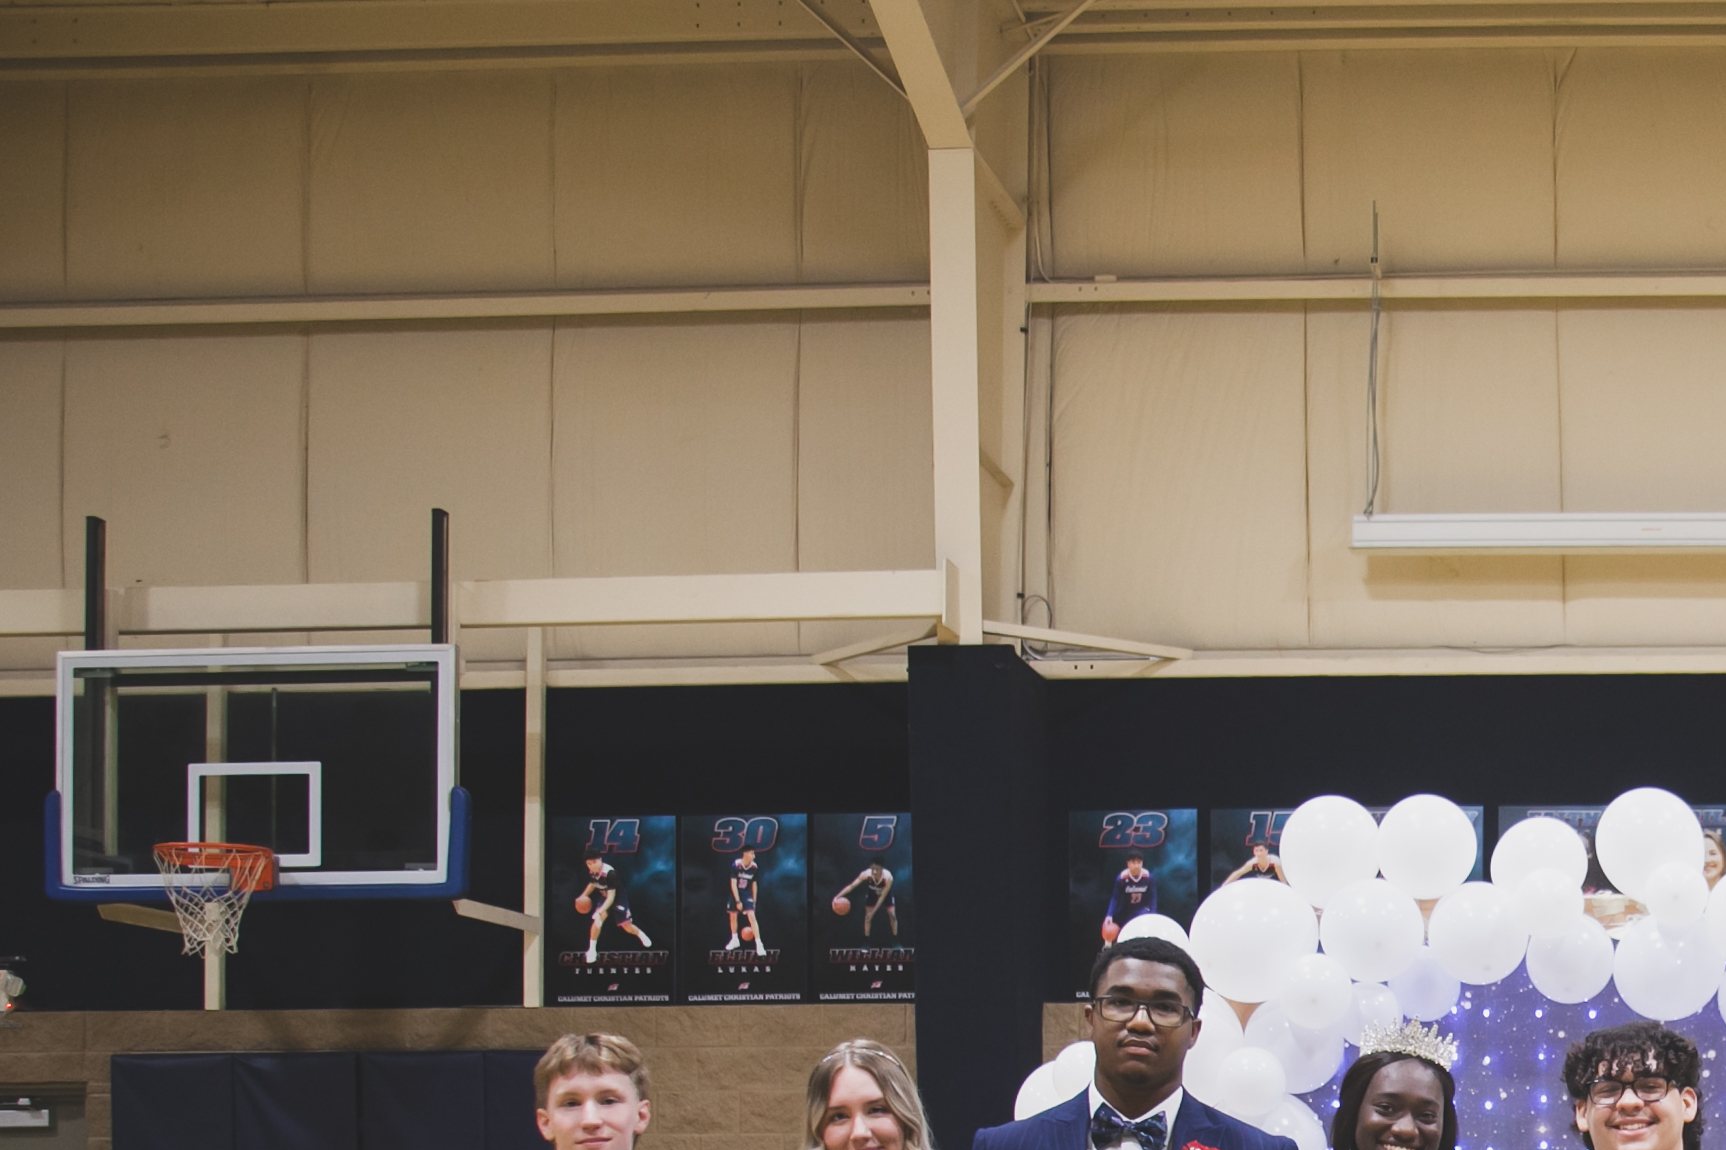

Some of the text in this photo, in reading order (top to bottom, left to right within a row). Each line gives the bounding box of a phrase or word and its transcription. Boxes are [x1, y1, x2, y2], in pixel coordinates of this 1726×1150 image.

[584, 818, 640, 854] 14
[711, 816, 779, 854] 30
[858, 815, 898, 852] 5
[1098, 812, 1168, 848] 23
[74, 874, 111, 885] SPALDING
[558, 951, 669, 967] CHISTIAN
[723, 993, 764, 1001] CHRISTIAN
